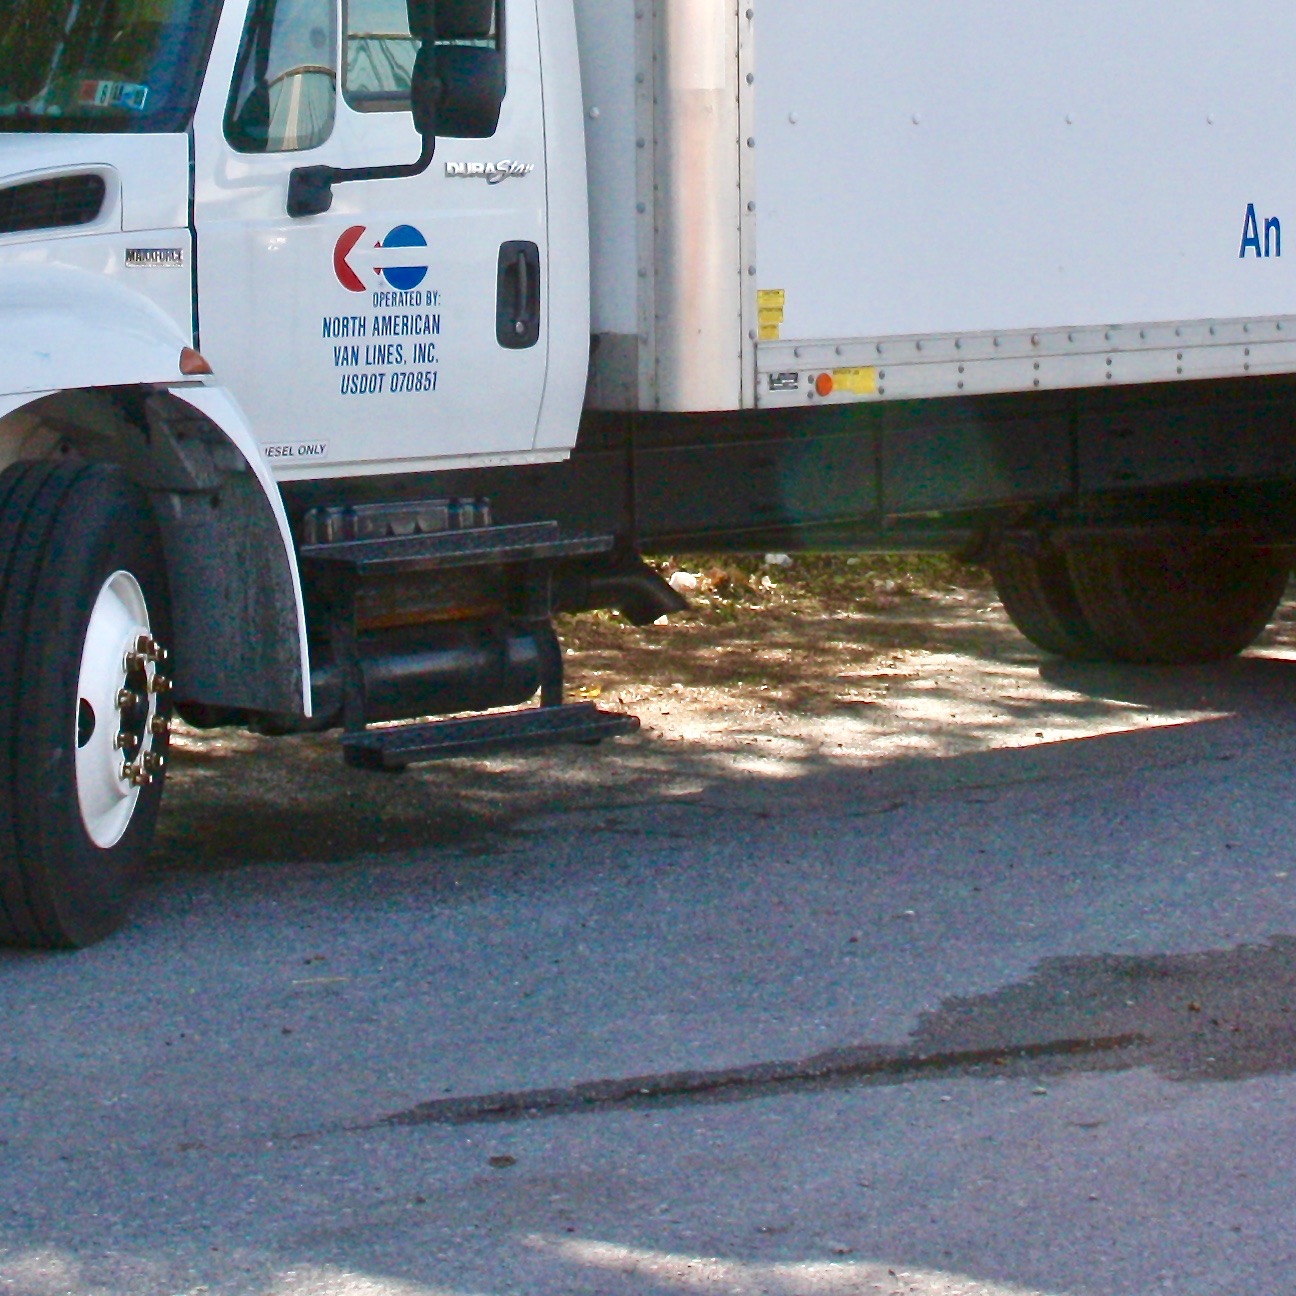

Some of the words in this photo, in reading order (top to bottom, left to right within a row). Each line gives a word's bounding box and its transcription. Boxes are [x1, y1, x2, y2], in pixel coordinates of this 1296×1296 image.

[1238, 202, 1282, 259] An
[372, 290, 422, 308] OPERATED
[425, 290, 441, 306] BY:
[322, 316, 366, 338] NORTH
[372, 314, 440, 337] AMERICAN
[333, 345, 359, 366] VAN
[413, 342, 439, 364] INC.
[340, 373, 385, 395] USDOT
[390, 371, 437, 393] 070851
[263, 446, 294, 457] IESEL
[297, 444, 326, 456] ONLY
